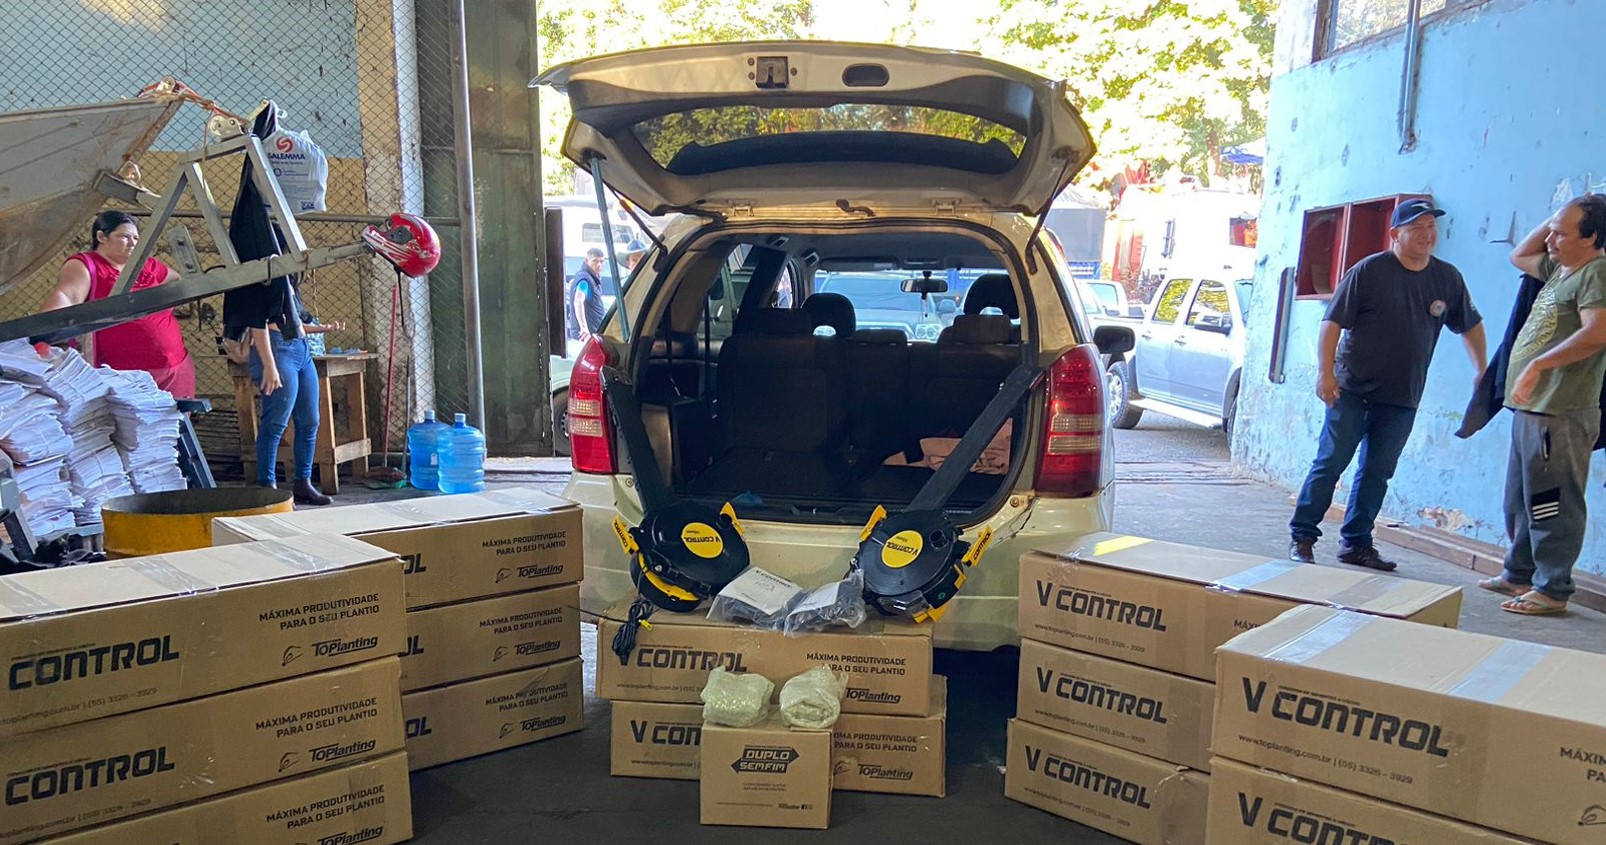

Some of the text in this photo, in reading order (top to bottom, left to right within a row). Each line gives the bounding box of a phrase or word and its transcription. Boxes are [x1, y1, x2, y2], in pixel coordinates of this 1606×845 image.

[482, 531, 566, 548] MÁXIMA PRODUTIVIDADE
[496, 548, 515, 556] PARA
[523, 544, 537, 552] SEU
[538, 540, 566, 551] PLANTIO
[259, 593, 379, 622] MÁXIMA PRODUTIVIDADE
[280, 605, 379, 630] PARA O SEU PLANTIO
[479, 607, 562, 627] MÁXIMA PRODUTIVIDADE
[1036, 580, 1167, 632] V CONTROL
[493, 626, 512, 635] PARA
[520, 622, 534, 630] SEU
[534, 616, 562, 628] PLANTIO
[9, 635, 179, 690] CONTROL
[637, 648, 747, 672] CONTROL
[806, 653, 906, 665] MÁXIMA PRODUTIVIDADE
[828, 664, 843, 672] ARA
[870, 667, 905, 676] PLANTIO
[1036, 666, 1053, 693] V
[1056, 677, 1167, 724] CONTROL
[300, 697, 377, 720] PRODUTIVIDADE
[1242, 677, 1267, 713] V
[1271, 691, 1450, 758] CONTROL
[276, 708, 378, 738] PARA O SEU PLANTIO
[630, 720, 700, 745] V CON
[834, 741, 855, 749] PARA
[882, 744, 917, 752] PLANTIO
[853, 733, 917, 743] PRODUTIVIDADE
[739, 762, 786, 771] SEMFIM
[745, 750, 790, 760] DUPLO
[5, 746, 175, 806] CONTROL
[1025, 745, 1041, 772] V
[1044, 756, 1151, 810] CONTROL
[266, 784, 384, 822] MÁXIMA PRODUTIVIDADE
[287, 795, 385, 829] PARA O SEU PLANTIO
[1238, 792, 1263, 827] V
